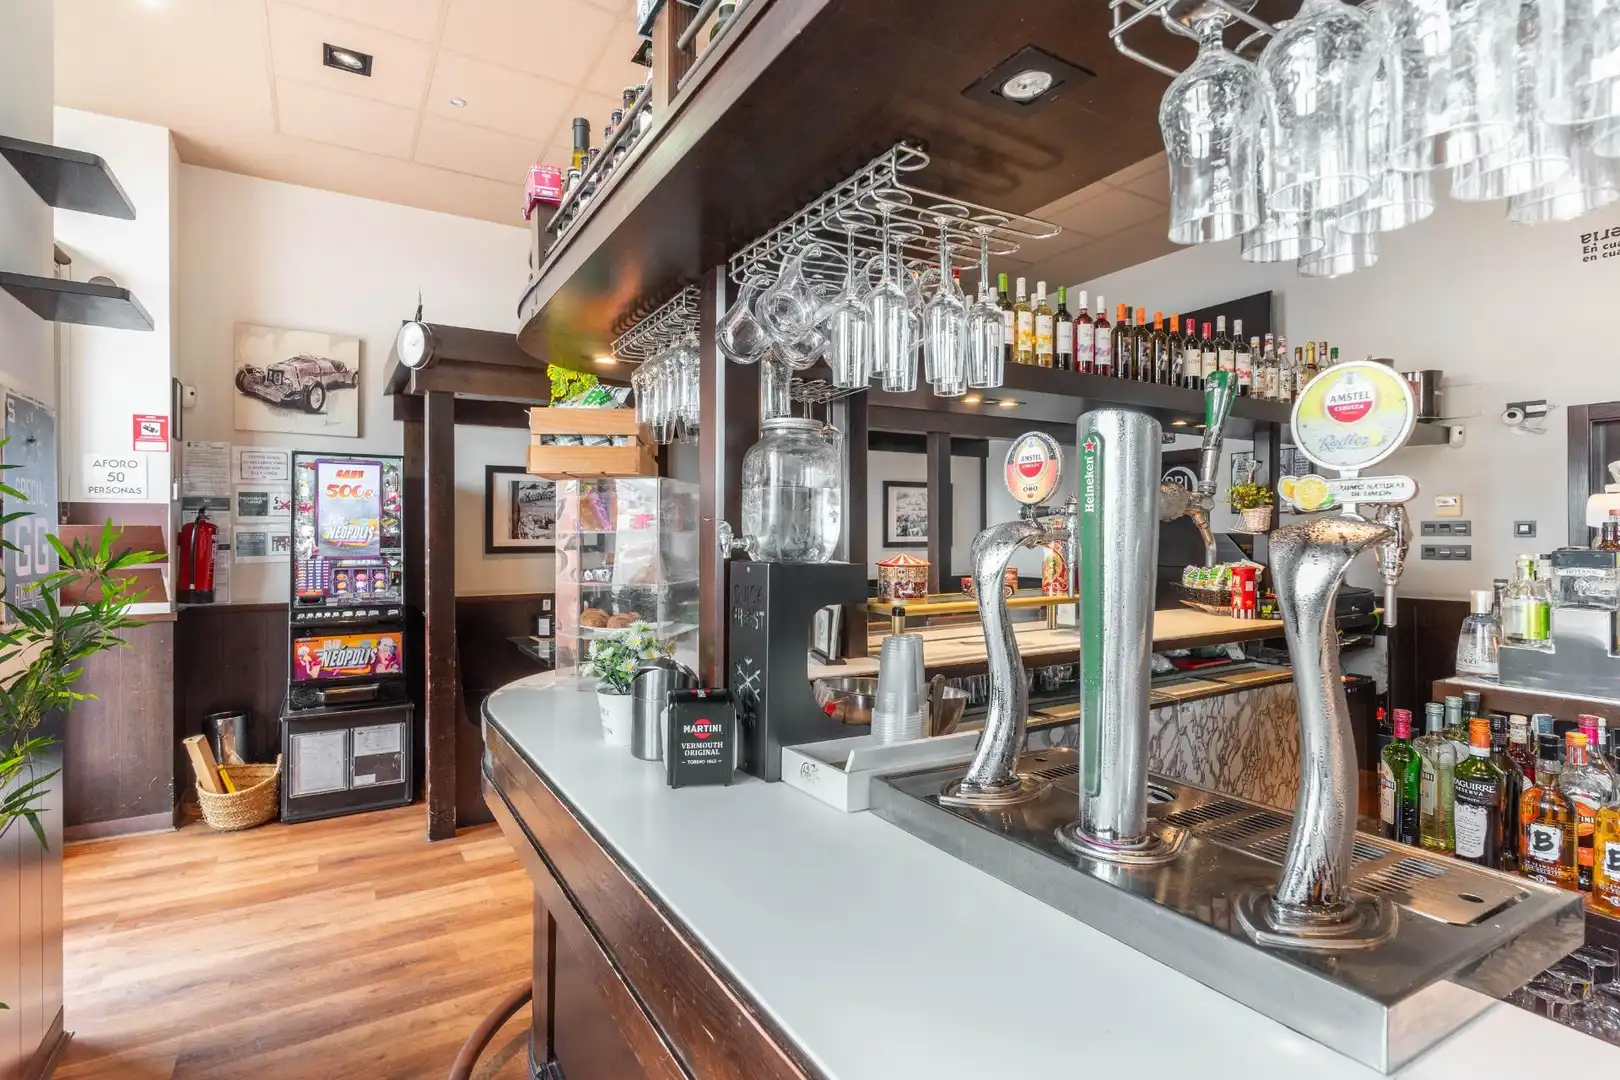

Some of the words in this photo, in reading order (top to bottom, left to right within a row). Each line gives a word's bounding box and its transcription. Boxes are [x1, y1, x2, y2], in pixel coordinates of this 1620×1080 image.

[1583, 246, 1597, 254] En
[1330, 391, 1371, 403] AMSTEL
[1318, 433, 1370, 452] Radler
[1021, 453, 1042, 462] AMSTEL
[92, 459, 139, 469] AFORO
[106, 471, 125, 483] 50
[1084, 456, 1094, 513] Heineken
[88, 486, 142, 495] PERSONAS
[683, 724, 722, 733] MARTINI
[681, 741, 723, 750] VERMOUTH
[1455, 785, 1483, 797] RESERVA
[1533, 829, 1554, 851] B
